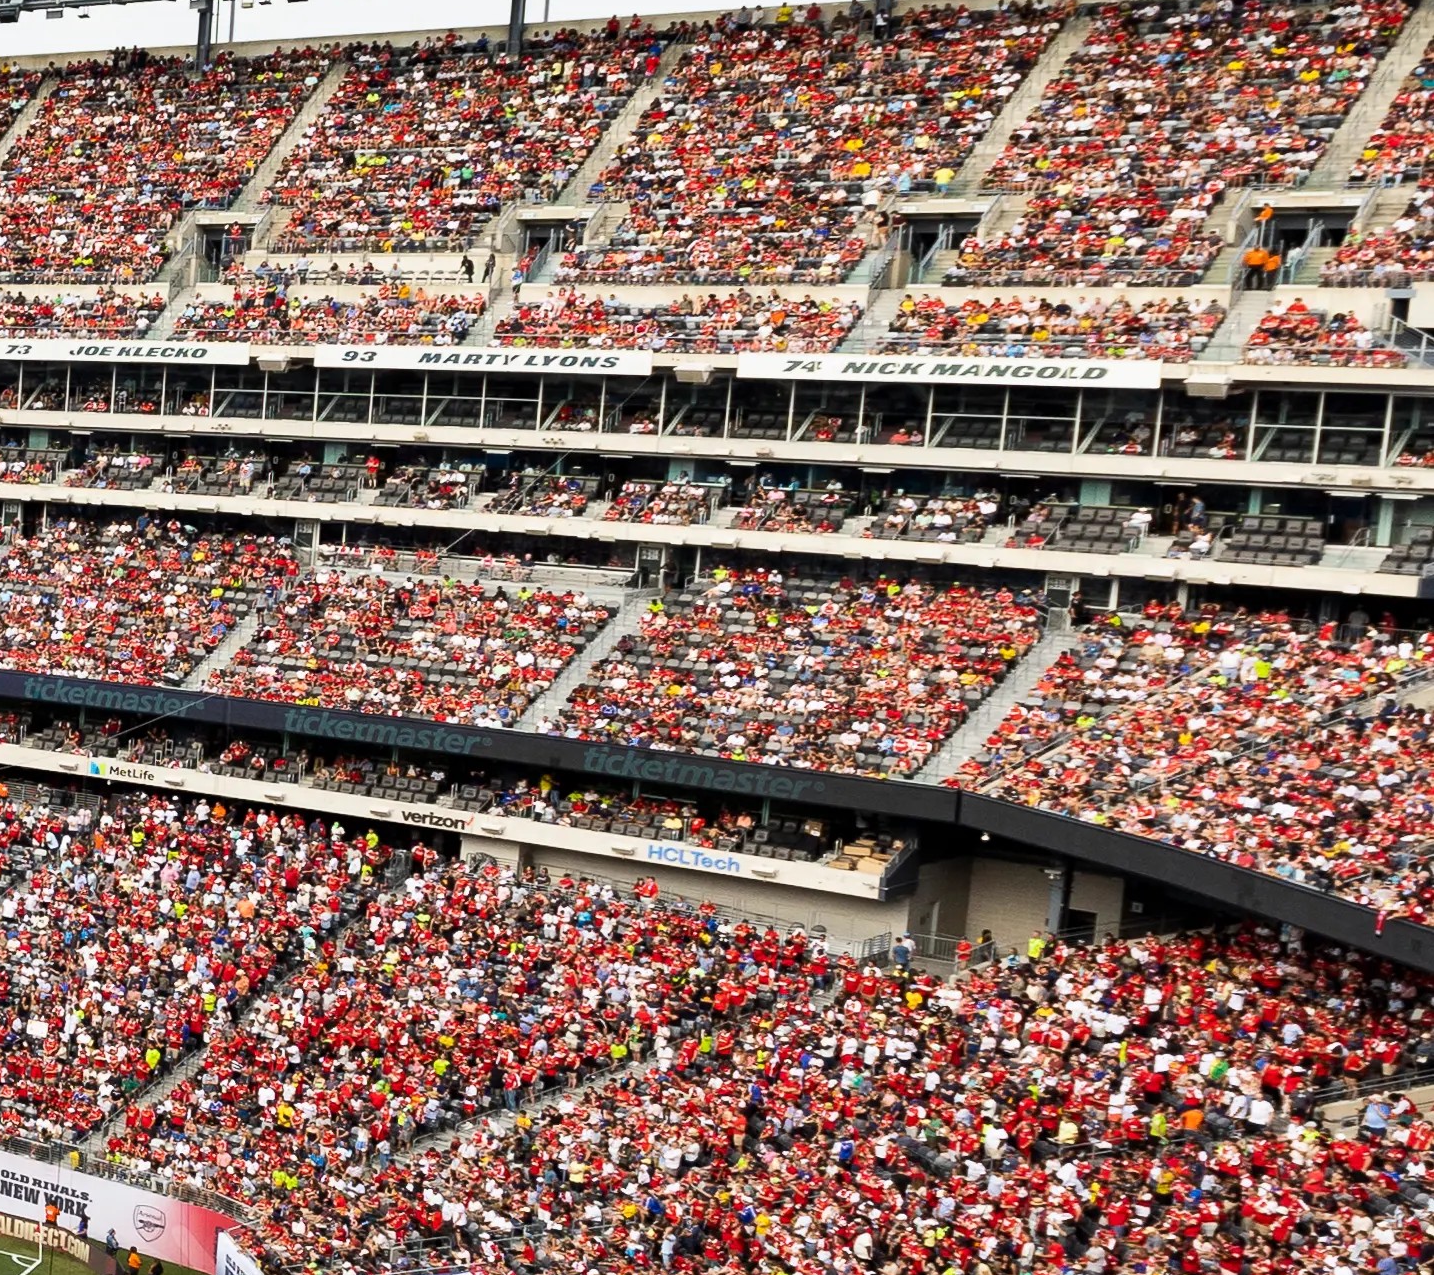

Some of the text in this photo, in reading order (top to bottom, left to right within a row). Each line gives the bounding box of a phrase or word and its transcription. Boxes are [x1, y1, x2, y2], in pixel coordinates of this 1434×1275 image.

[3, 344, 208, 359] 73 JOE KLECKO
[341, 349, 620, 369] 93 MARTY LYONS
[783, 359, 1108, 382] 74 NICK MANGOLD
[110, 766, 155, 781] MetLife
[401, 811, 466, 830] verizon
[648, 844, 740, 873] HCLTech
[0, 1168, 93, 1203] OLD RIVALS.
[0, 1179, 41, 1205] NEW
